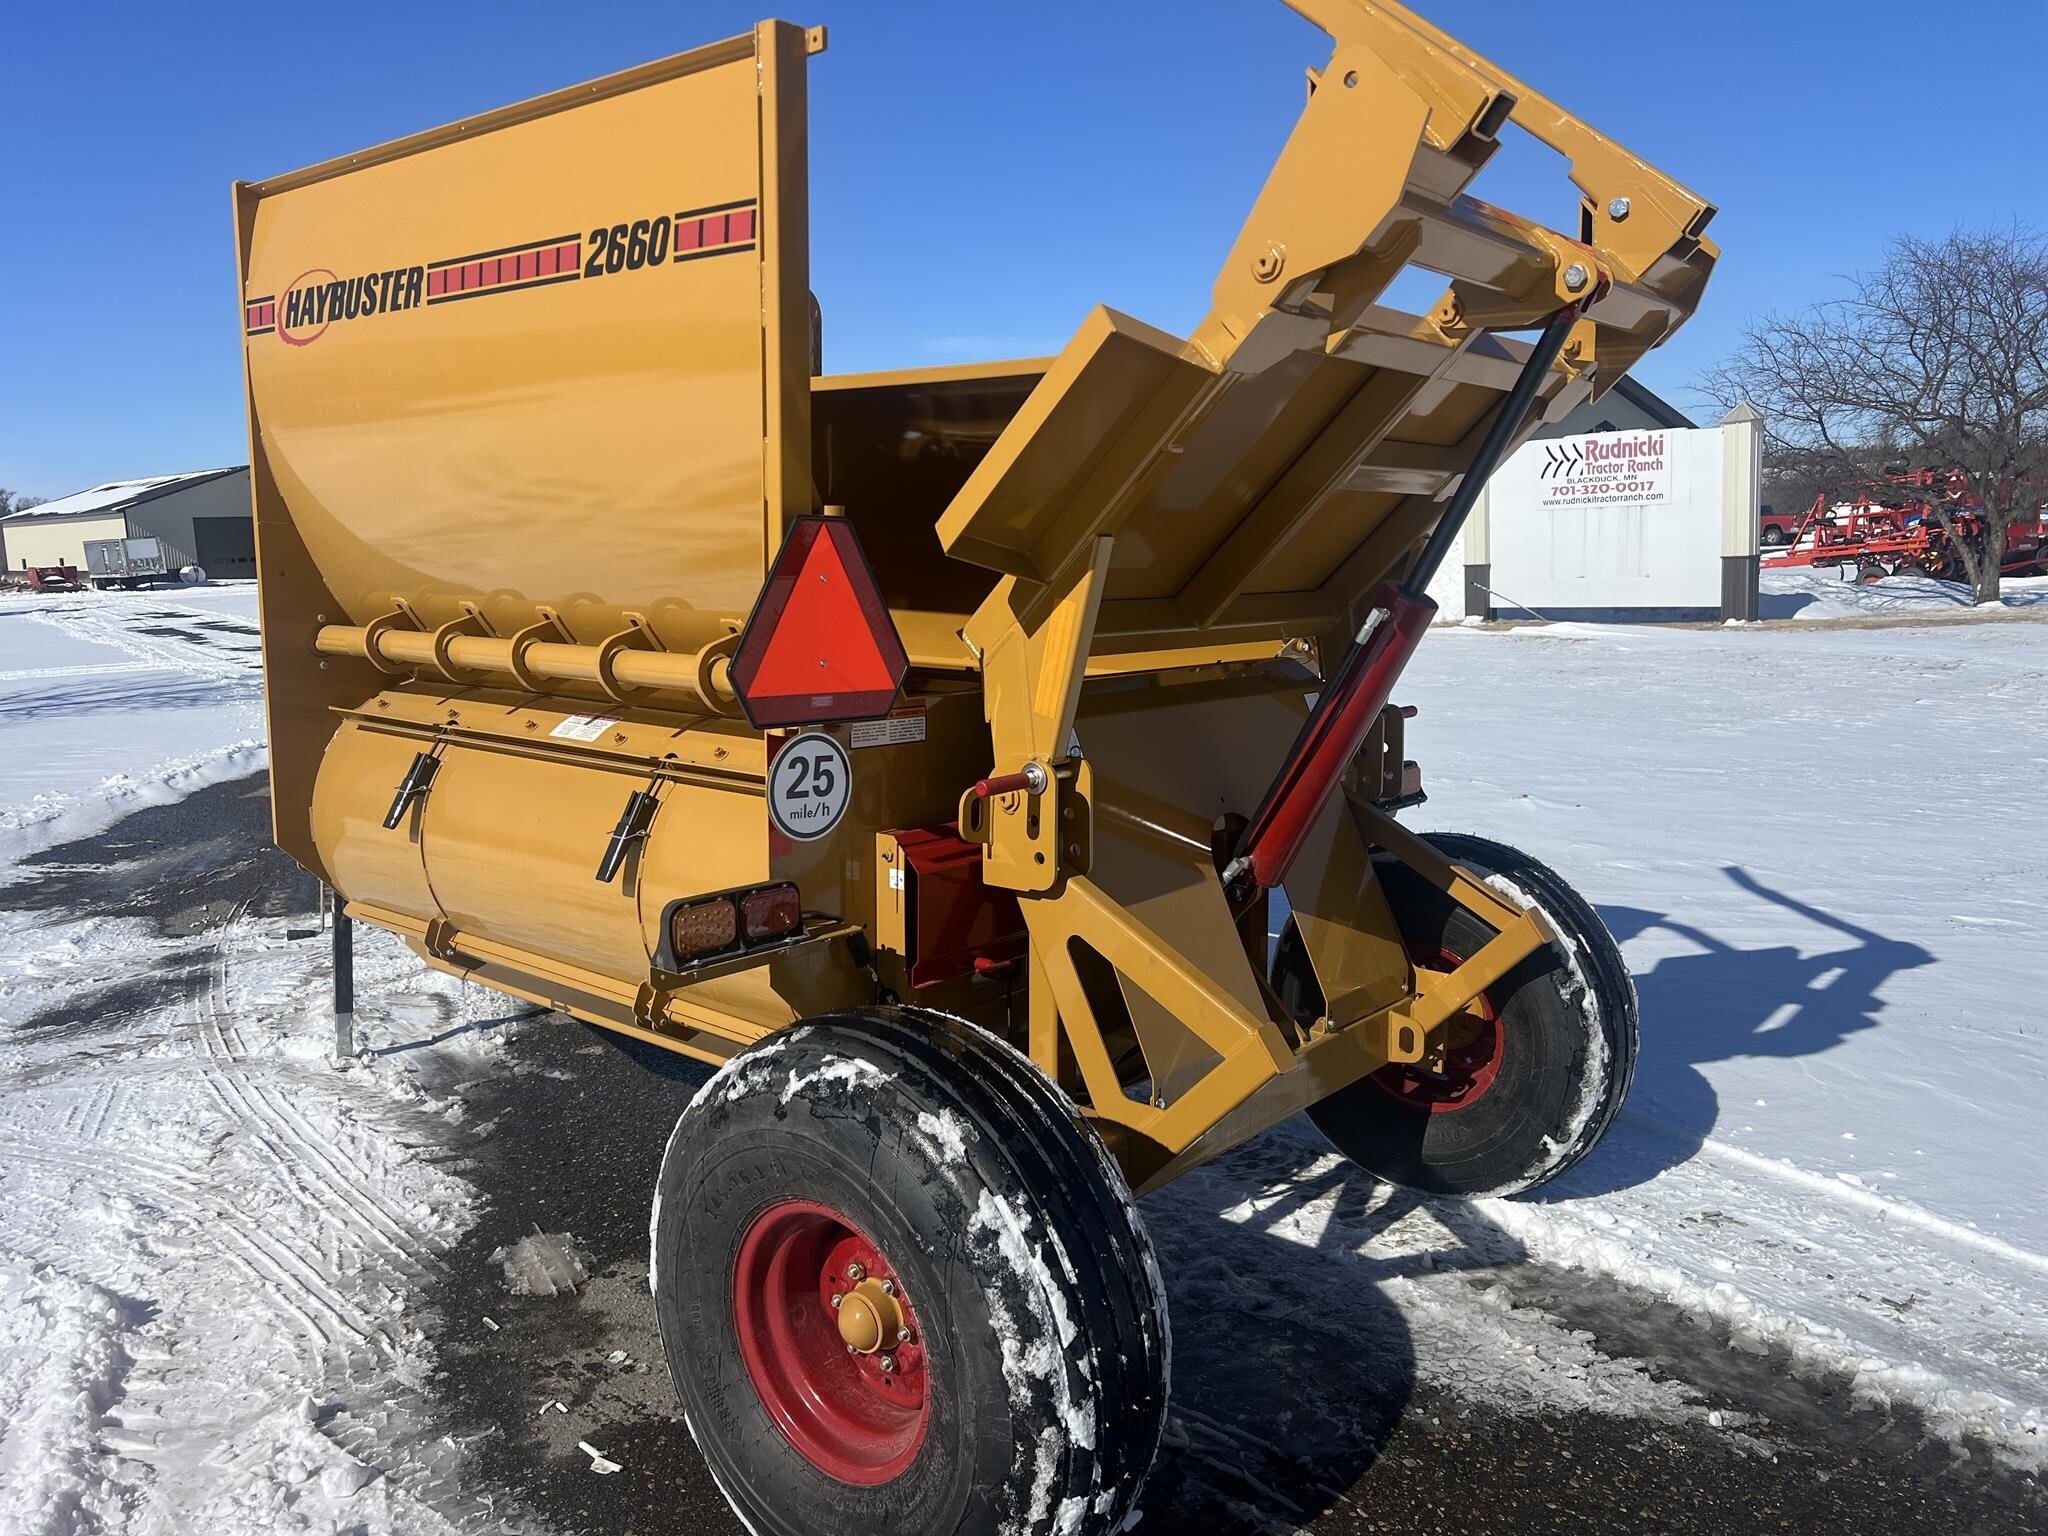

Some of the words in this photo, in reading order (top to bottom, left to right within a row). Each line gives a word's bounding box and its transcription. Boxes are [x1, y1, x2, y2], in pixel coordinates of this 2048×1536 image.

[284, 265, 425, 329] HAYBUSTER
[583, 215, 672, 279] 2660
[1585, 434, 1664, 463] Rudnicki
[1585, 462, 1624, 476] Tractor
[1627, 458, 1664, 474] Ranch
[1623, 474, 1638, 482] MN
[1551, 481, 1655, 497] 701-320-0017
[1542, 492, 1664, 506] www.rudnickitractorranch.com
[785, 754, 835, 800] 25
[789, 802, 830, 820] mile/h
